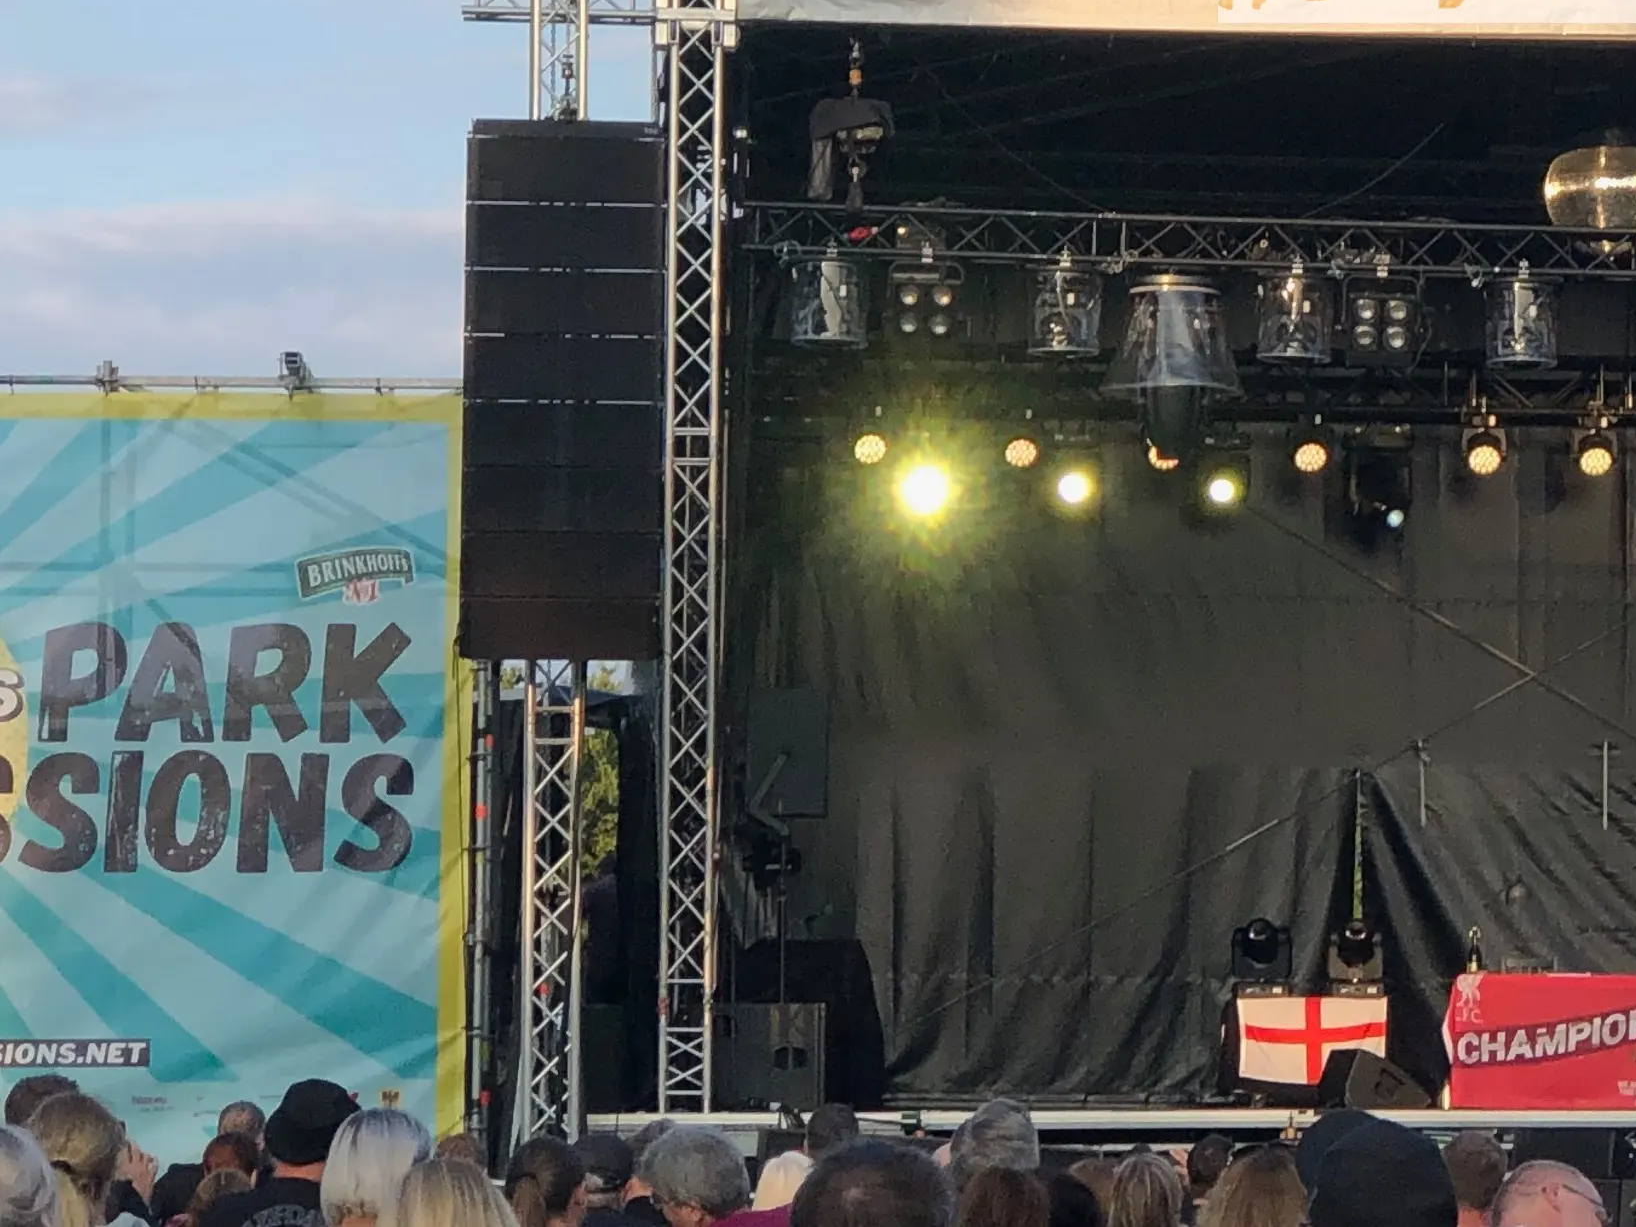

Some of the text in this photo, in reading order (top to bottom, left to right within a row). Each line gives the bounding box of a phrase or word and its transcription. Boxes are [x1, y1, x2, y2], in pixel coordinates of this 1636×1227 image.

[37, 621, 412, 744] PARK
[0, 749, 414, 873] SIONS
[0, 1042, 147, 1065] IONS.NET
